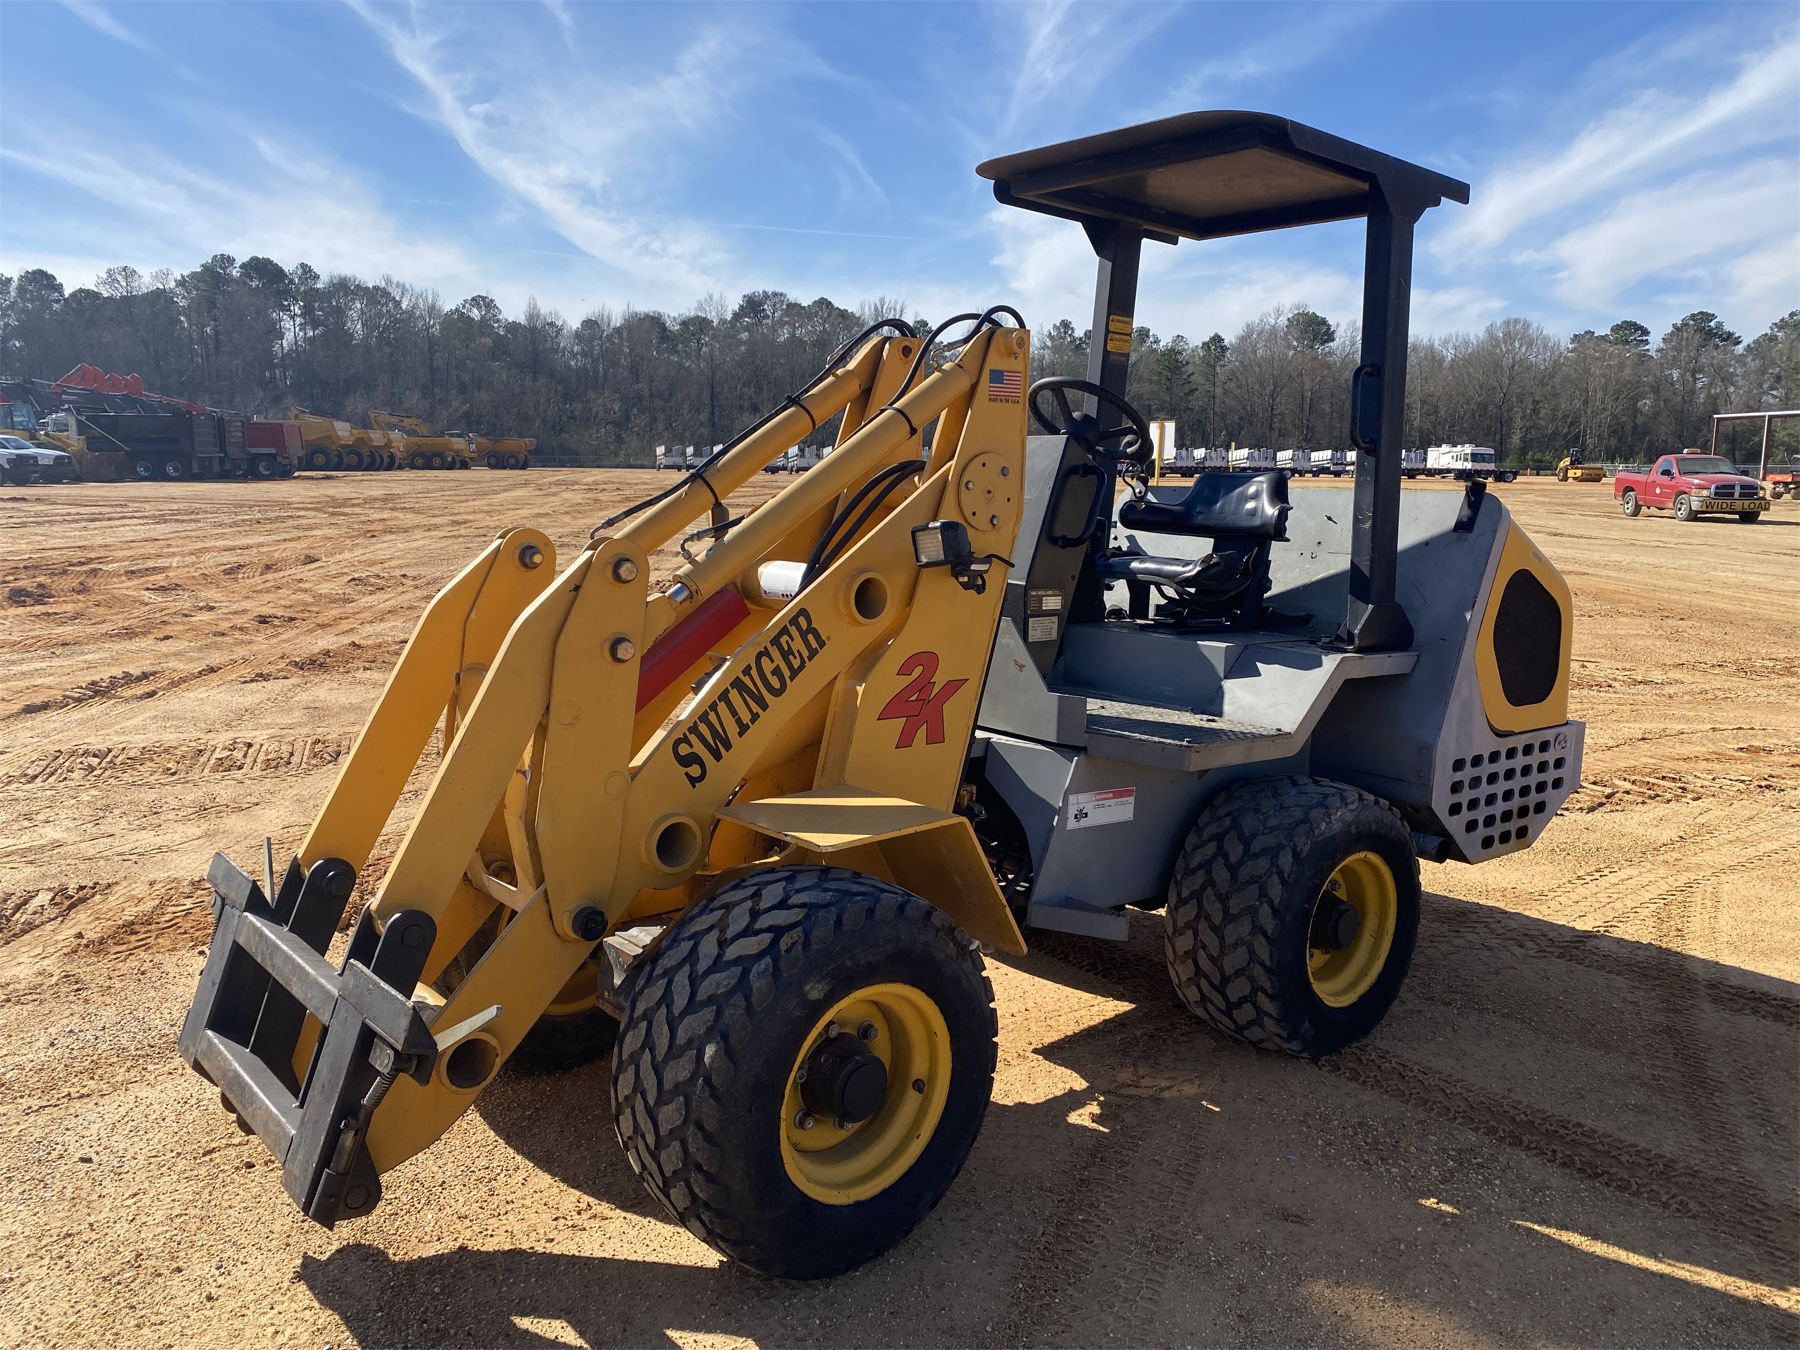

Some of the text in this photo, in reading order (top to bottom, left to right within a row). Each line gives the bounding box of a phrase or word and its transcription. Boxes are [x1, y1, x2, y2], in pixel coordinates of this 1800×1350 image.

[1705, 501, 1770, 510] WIDE LOAD
[672, 607, 827, 789] SWINGER
[877, 651, 969, 749] 2K
